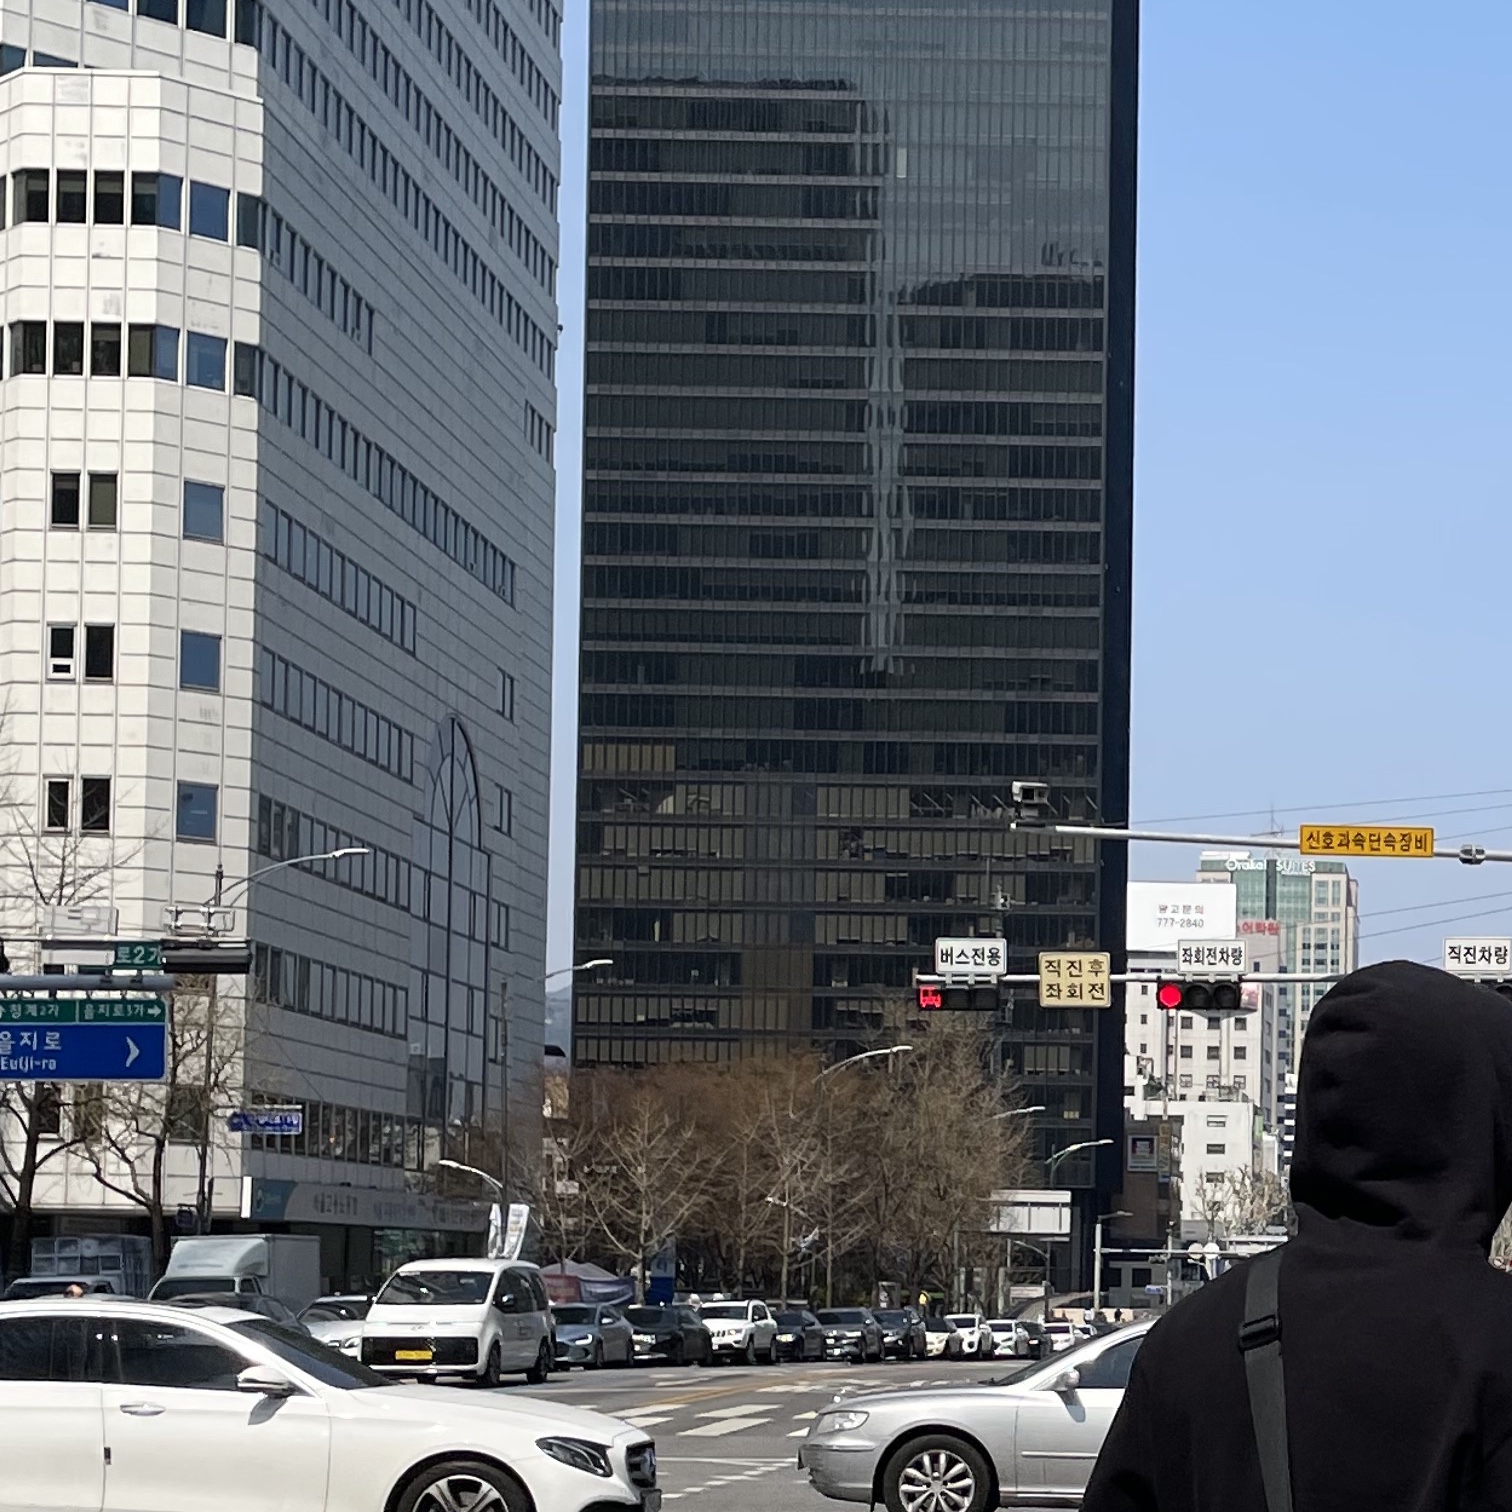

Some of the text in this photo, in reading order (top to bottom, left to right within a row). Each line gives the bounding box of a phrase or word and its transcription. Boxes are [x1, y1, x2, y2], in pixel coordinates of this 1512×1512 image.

[1306, 831, 1428, 852] 신호과속단속장비
[116, 945, 163, 964] 로2가
[940, 947, 1001, 966] 버스전용
[1182, 946, 1243, 966] 좌회전차량
[1448, 945, 1508, 964] 직진차량
[1045, 959, 1104, 978] 직진후
[1045, 982, 1105, 1000] 좌회전
[84, 1004, 143, 1020] 을지로3가
[0, 1031, 61, 1055] 을지로
